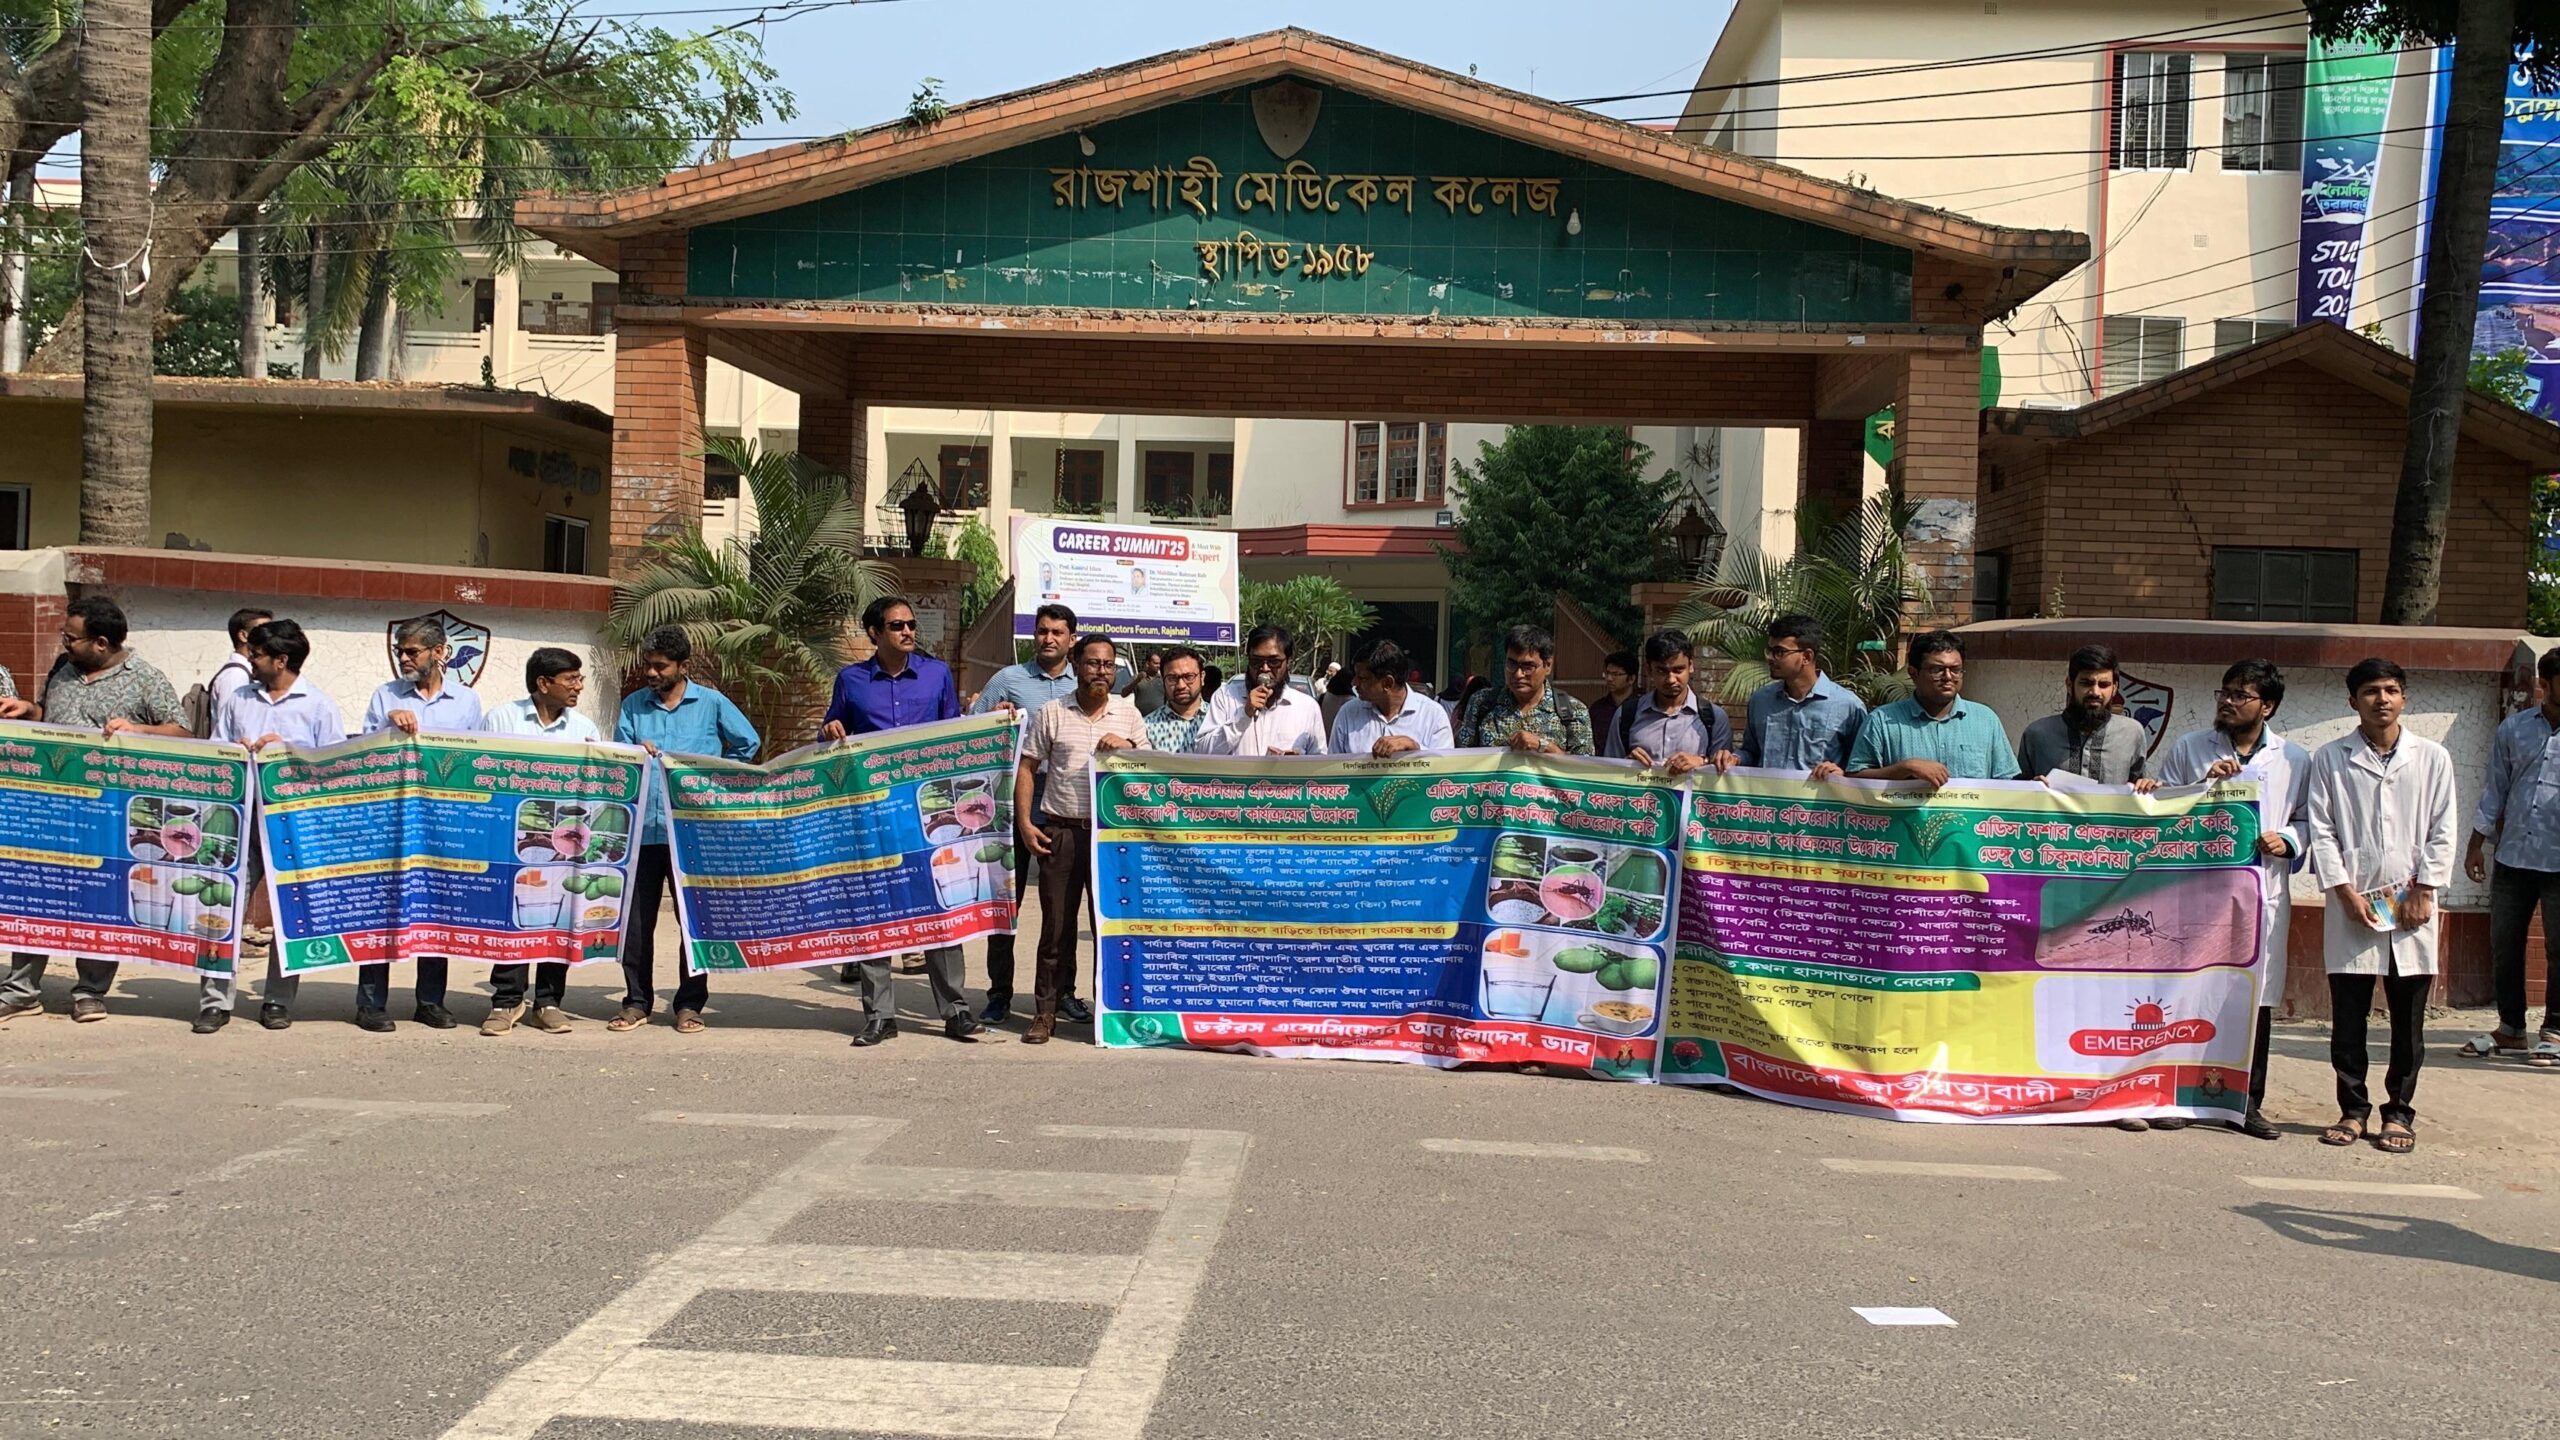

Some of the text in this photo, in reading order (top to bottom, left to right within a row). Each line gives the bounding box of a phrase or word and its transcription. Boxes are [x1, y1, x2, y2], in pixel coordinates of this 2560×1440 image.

[1049, 155, 1562, 216] রাজশাহী মেডিকেল কলেজ
[1197, 230, 1375, 280] স্থাপিত-১৯৫৮
[1059, 532, 1185, 556] CAREER SUMMIT'25
[1192, 551, 1220, 563] Expert
[1105, 624, 1134, 634] Doctors
[1135, 625, 1160, 636] Forum,
[1161, 626, 1190, 637] Rajshahi
[1154, 782, 1166, 797] ও
[1426, 779, 1468, 800] এডিস
[1472, 781, 1507, 800] মশার
[1430, 805, 1462, 825] ডেঙ্গু
[1465, 806, 1479, 821] ও
[1560, 809, 1625, 836] প্রতিরোধ
[1629, 816, 1659, 839] করি
[1779, 807, 1840, 830] প্রতিরোধ
[1844, 808, 1891, 832] বিষয়ক
[1974, 807, 2239, 848] এডিস মশার প্রজননস্থল করি,
[1978, 834, 2236, 872] ডেঙ্গু ও চিকুনগুনিয়া করি
[71, 926, 97, 942] অব
[454, 933, 480, 946] অব
[746, 941, 793, 958] ডক্টরস
[798, 930, 880, 950] এসোসিয়েশন
[884, 925, 910, 938] অব
[1744, 960, 1956, 988] কখন হাসপাতালে নেবেন?
[1193, 1017, 1266, 1034] ডক্টরস
[1408, 1021, 1446, 1039] অব
[1541, 1033, 1590, 1057] ড্যাব
[2083, 1023, 2201, 1052] EMERGENCY
[1732, 1050, 1841, 1090] বাংলাদেশ
[1852, 1073, 2061, 1104] জাতীয়তাবাদী
